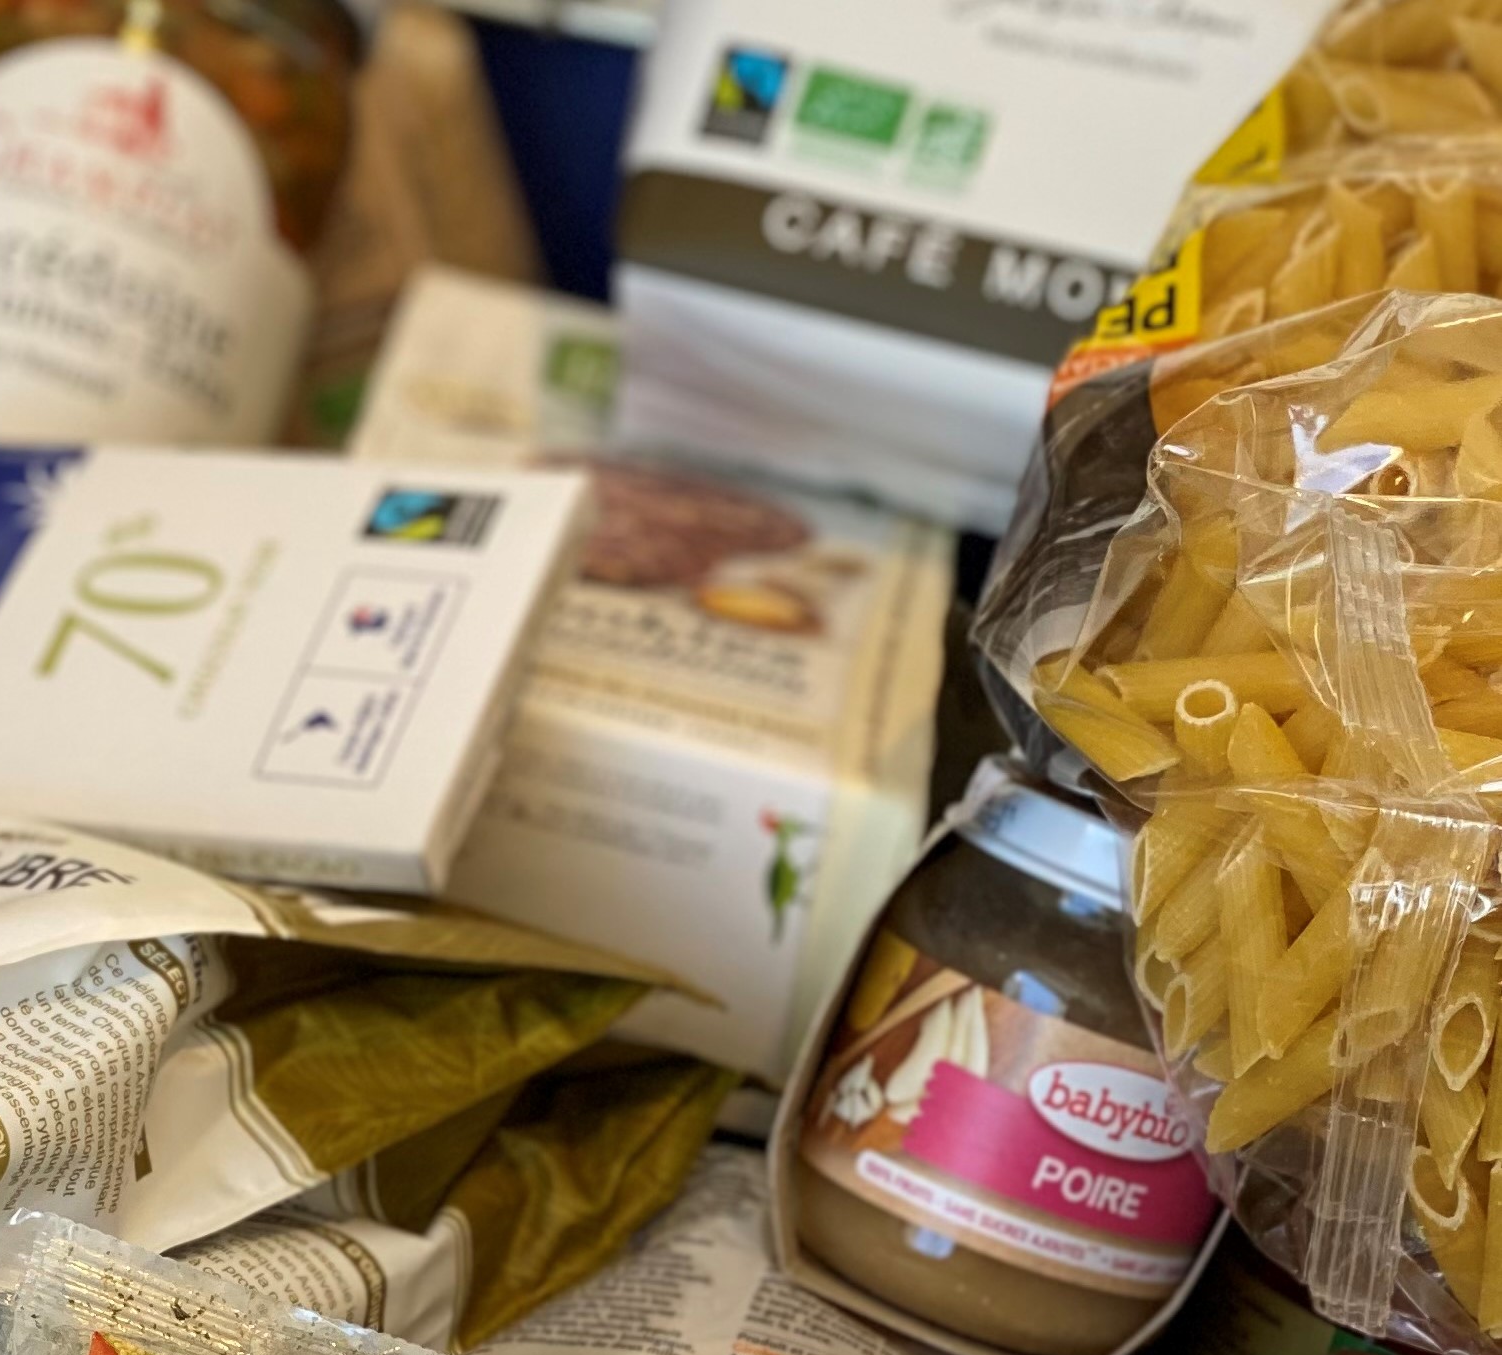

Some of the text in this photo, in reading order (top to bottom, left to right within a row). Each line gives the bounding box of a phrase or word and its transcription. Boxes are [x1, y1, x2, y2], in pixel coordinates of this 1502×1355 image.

[762, 189, 962, 289] CAFÉ
[1043, 1072, 1191, 1148] babybio
[1031, 1155, 1148, 1220] POIRE
